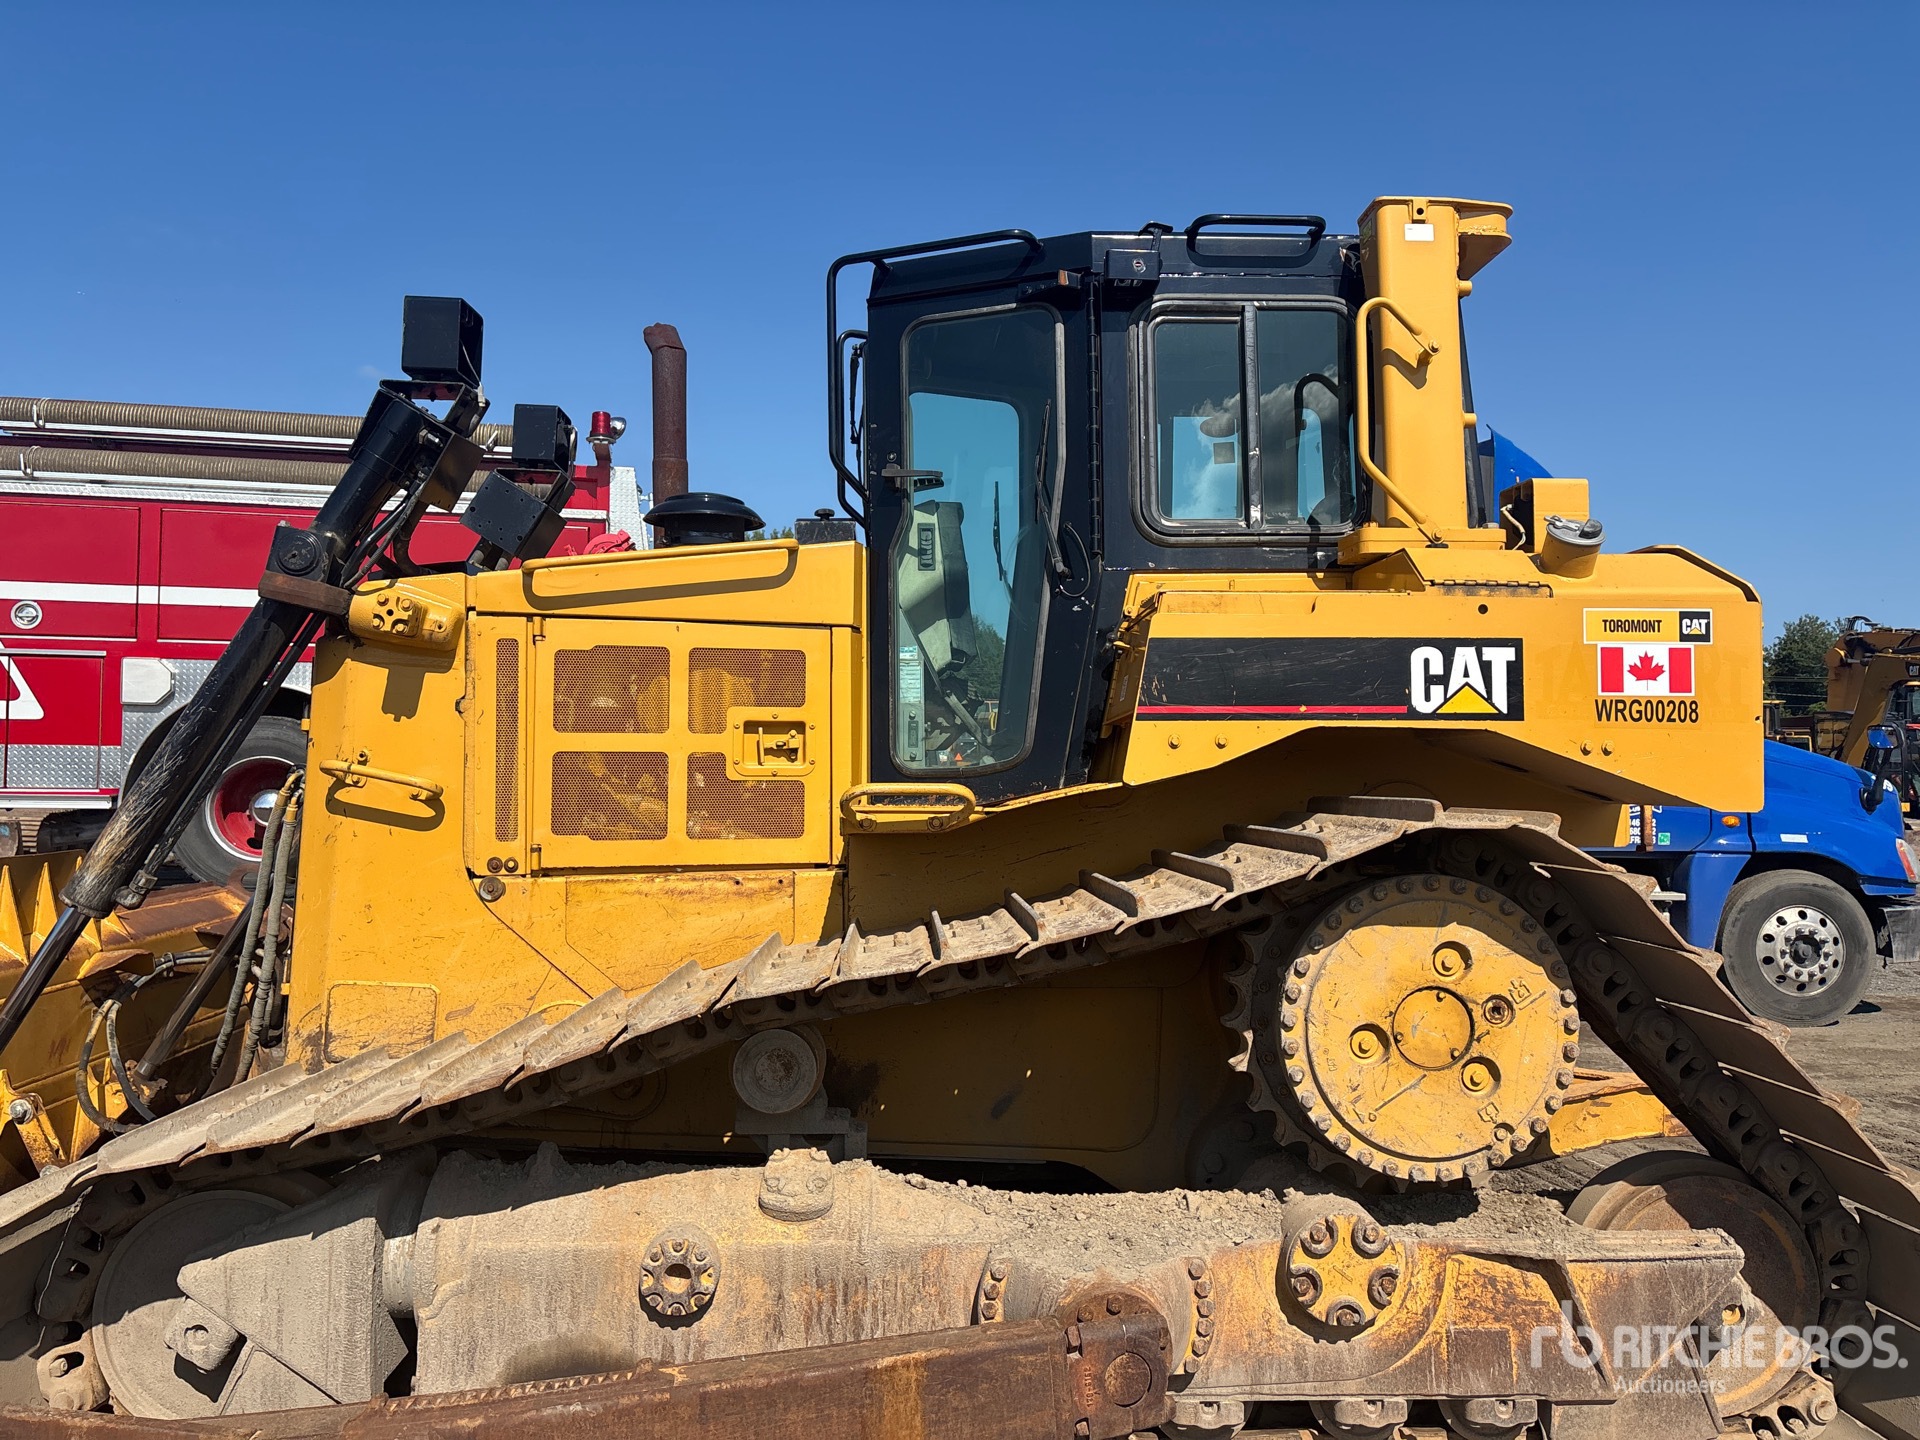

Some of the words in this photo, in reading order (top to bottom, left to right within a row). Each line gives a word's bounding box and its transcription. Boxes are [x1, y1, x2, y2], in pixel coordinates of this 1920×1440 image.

[1602, 619, 1662, 633] TOROMONT
[1681, 618, 1708, 635] CAT
[1410, 646, 1516, 714] CAT
[1909, 665, 1919, 676] CAT
[1595, 699, 1699, 723] WRG00208
